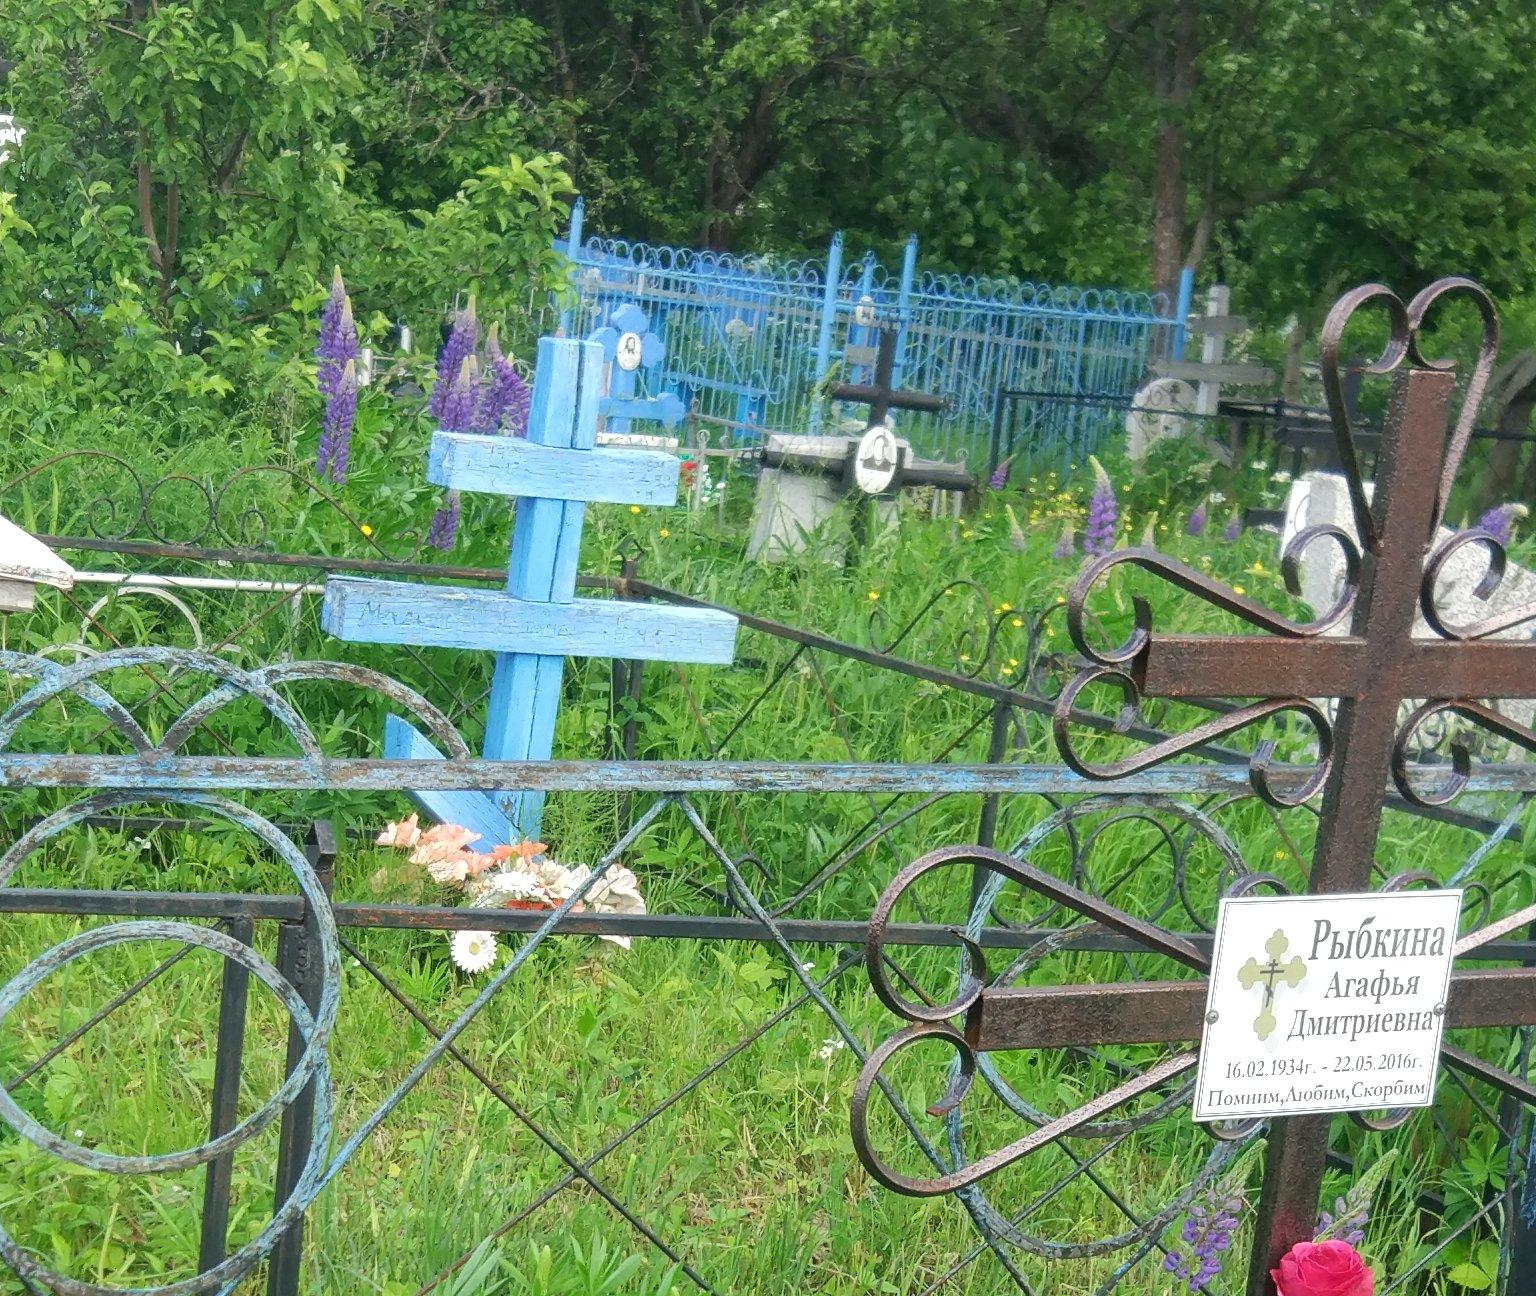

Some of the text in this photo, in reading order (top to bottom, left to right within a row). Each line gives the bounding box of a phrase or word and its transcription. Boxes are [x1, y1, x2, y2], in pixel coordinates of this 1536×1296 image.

[1308, 915, 1446, 961] Рыбкина
[1323, 968, 1421, 1004] Агафья
[1286, 1009, 1434, 1042] Дмитриевна
[1225, 1058, 1316, 1079] 16.02.1934г.
[1332, 1052, 1423, 1074] 22.05.2016г.
